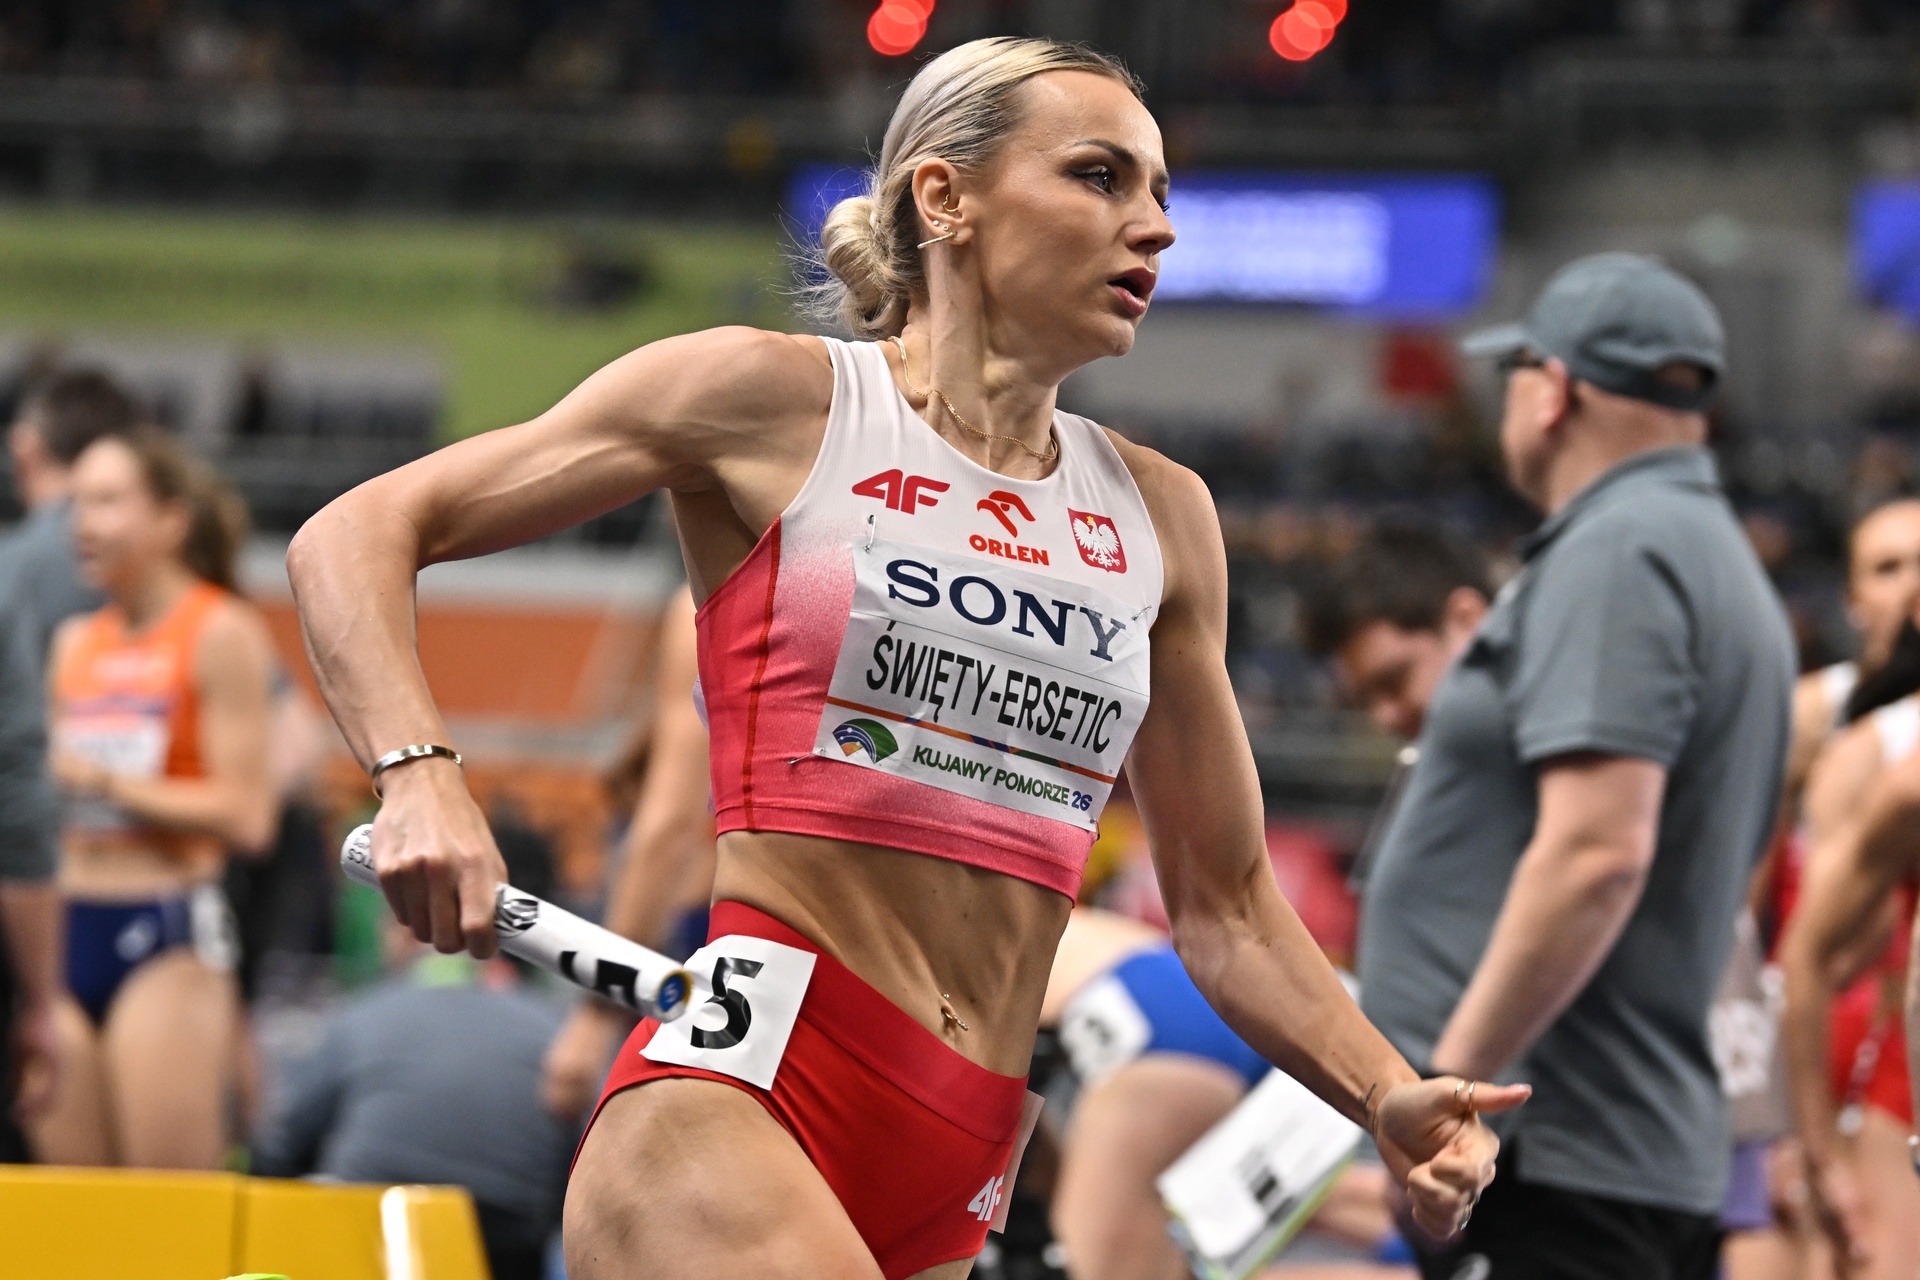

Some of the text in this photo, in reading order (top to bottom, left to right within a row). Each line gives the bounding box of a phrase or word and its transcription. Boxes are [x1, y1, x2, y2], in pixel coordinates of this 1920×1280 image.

[851, 468, 950, 515] 4F
[969, 534, 1050, 566] ORLEN
[886, 559, 1127, 662] SONY
[866, 620, 1121, 754] ŚWIĘTY-ERSETIC
[912, 745, 993, 783] KUJAWY
[993, 768, 1070, 806] POMORZE
[690, 956, 764, 1049] 5
